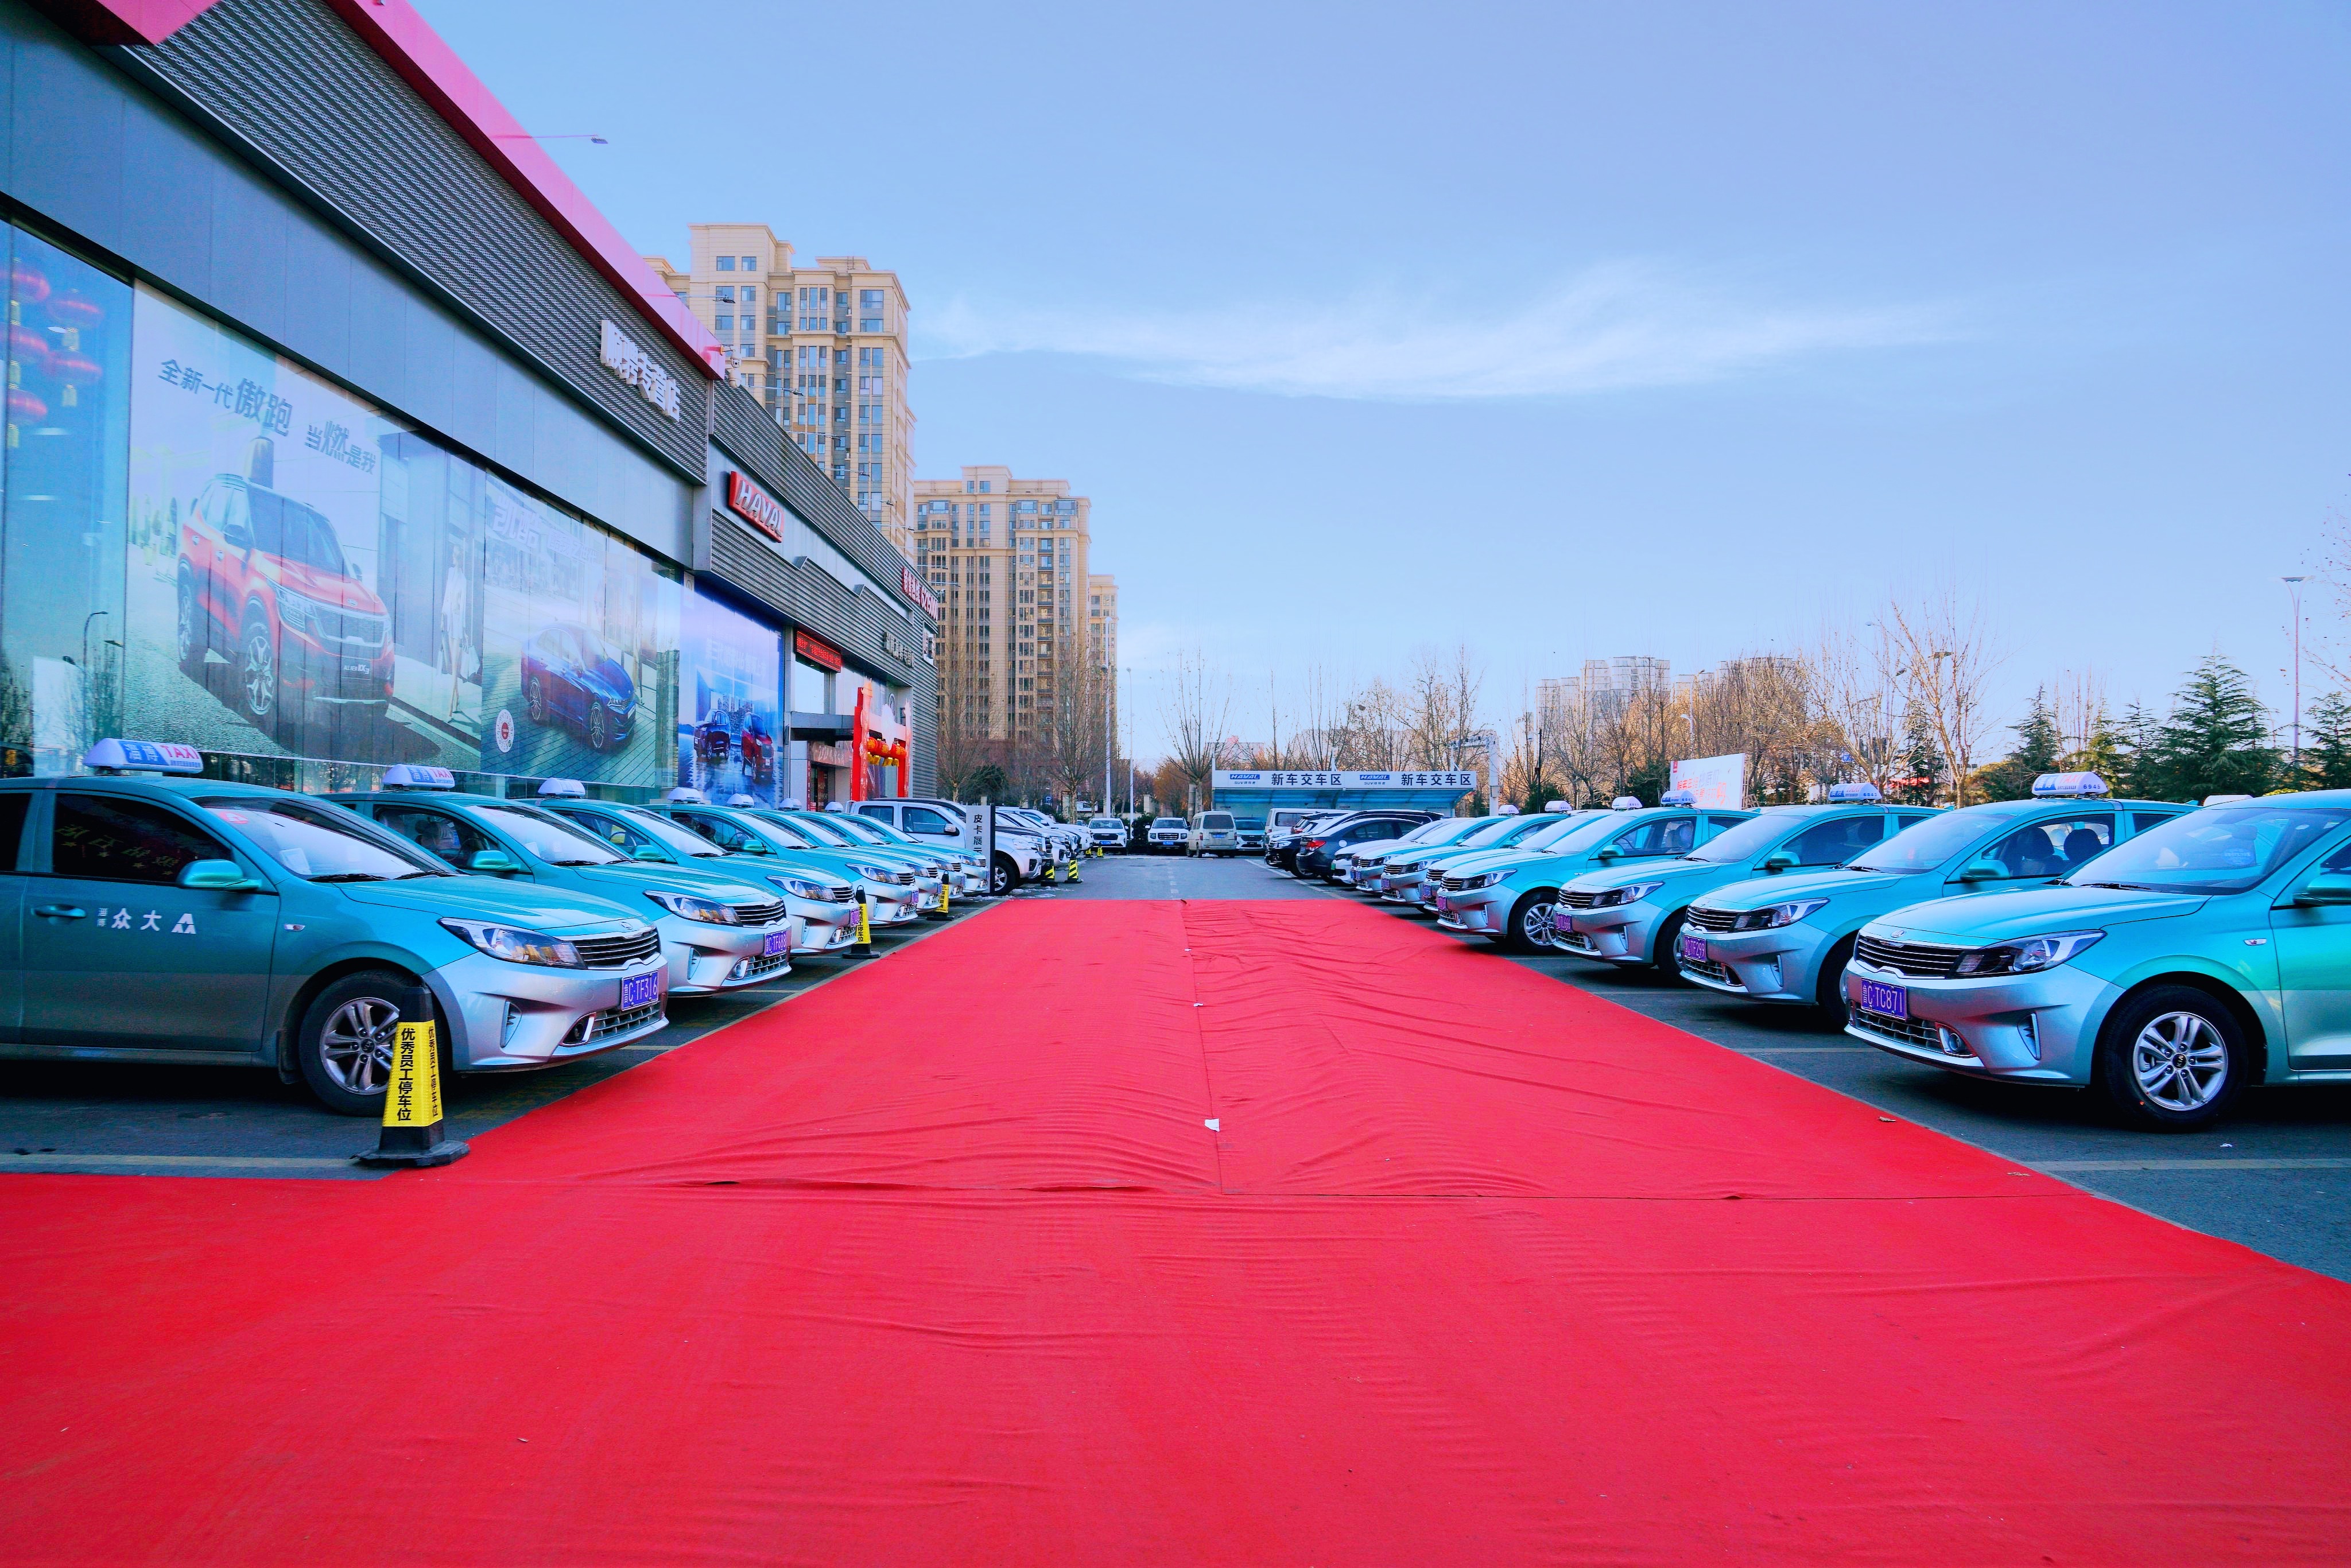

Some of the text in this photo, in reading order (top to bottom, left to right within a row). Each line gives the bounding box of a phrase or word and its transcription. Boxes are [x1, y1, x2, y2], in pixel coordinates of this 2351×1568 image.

[158, 359, 376, 475] 全新一代傲跑 当燃是我
[735, 480, 782, 537] HAVAL
[160, 745, 199, 759] TAXI
[1271, 773, 1342, 786] 新车交车区
[1401, 773, 1471, 786] 新车交车区
[397, 1028, 416, 1121] 优秀员工停车位
